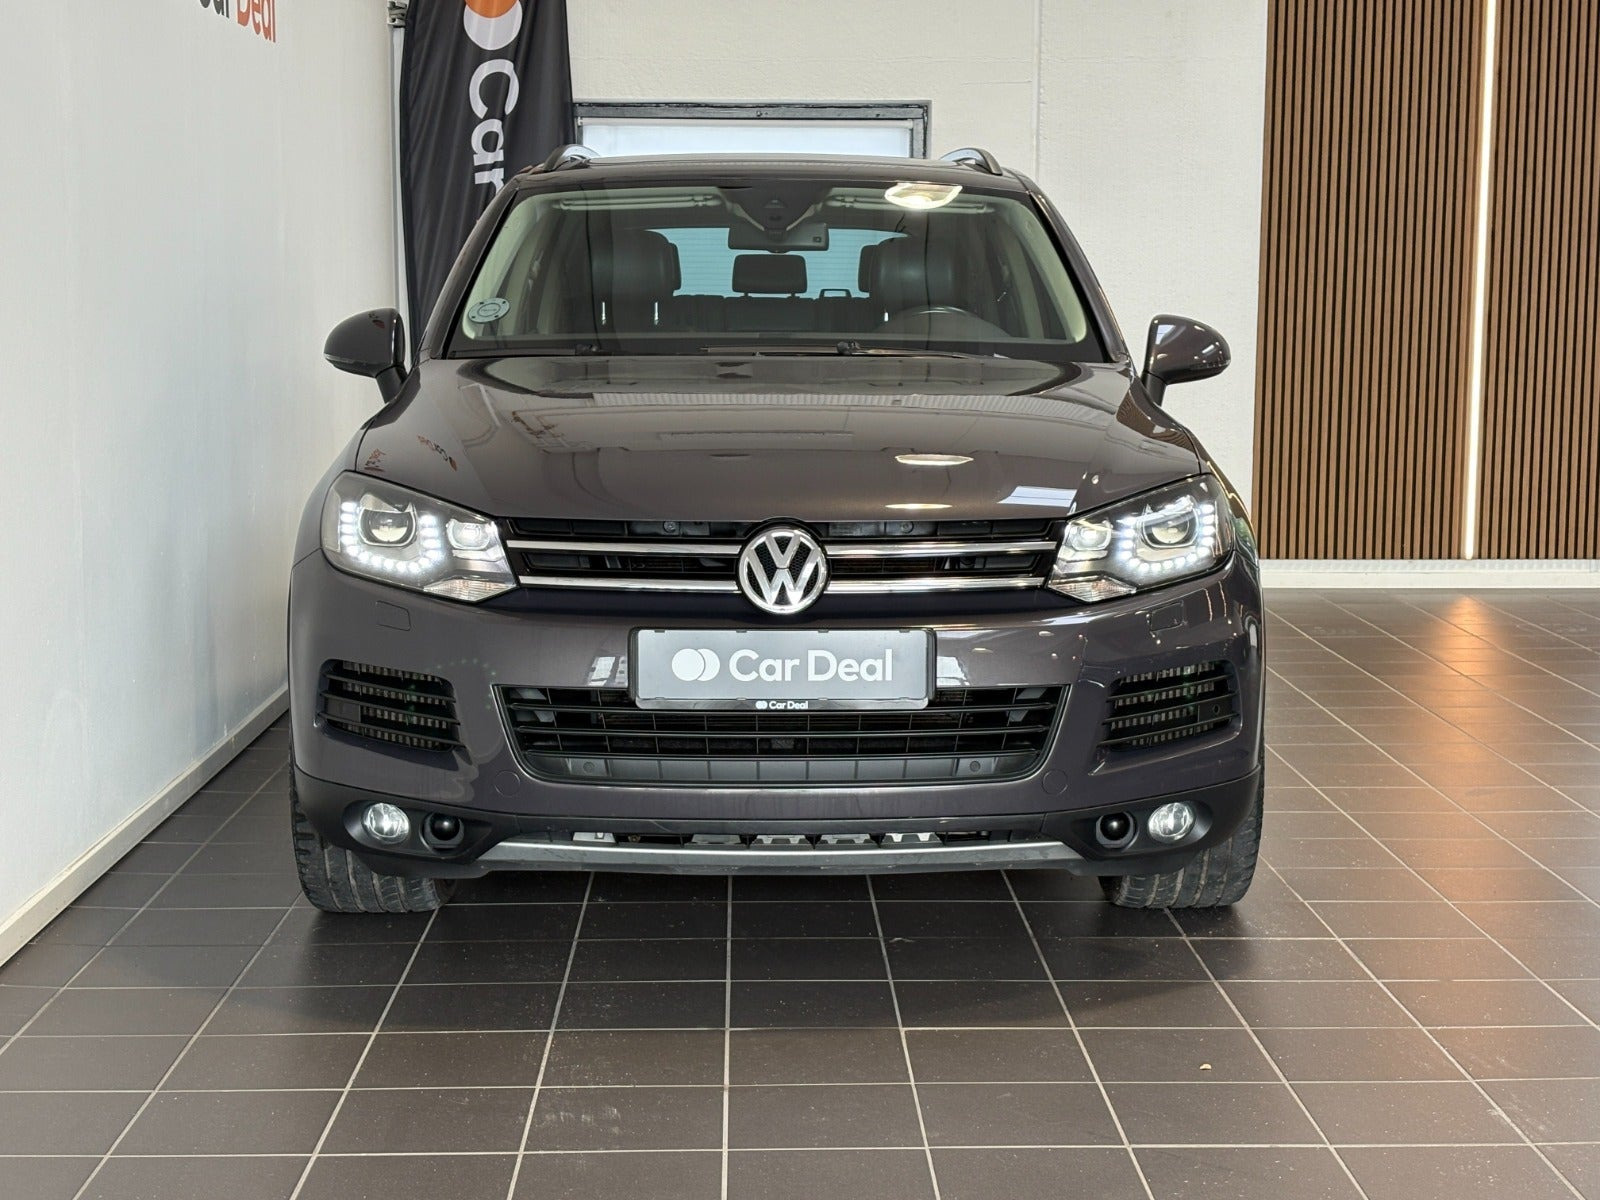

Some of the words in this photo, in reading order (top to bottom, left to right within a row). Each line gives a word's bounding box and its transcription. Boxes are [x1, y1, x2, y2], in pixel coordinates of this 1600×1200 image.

[469, 58, 520, 196] Car
[728, 648, 800, 682] Car
[807, 648, 893, 682] Deal
[768, 700, 786, 710] Car
[787, 700, 809, 710] Deal
